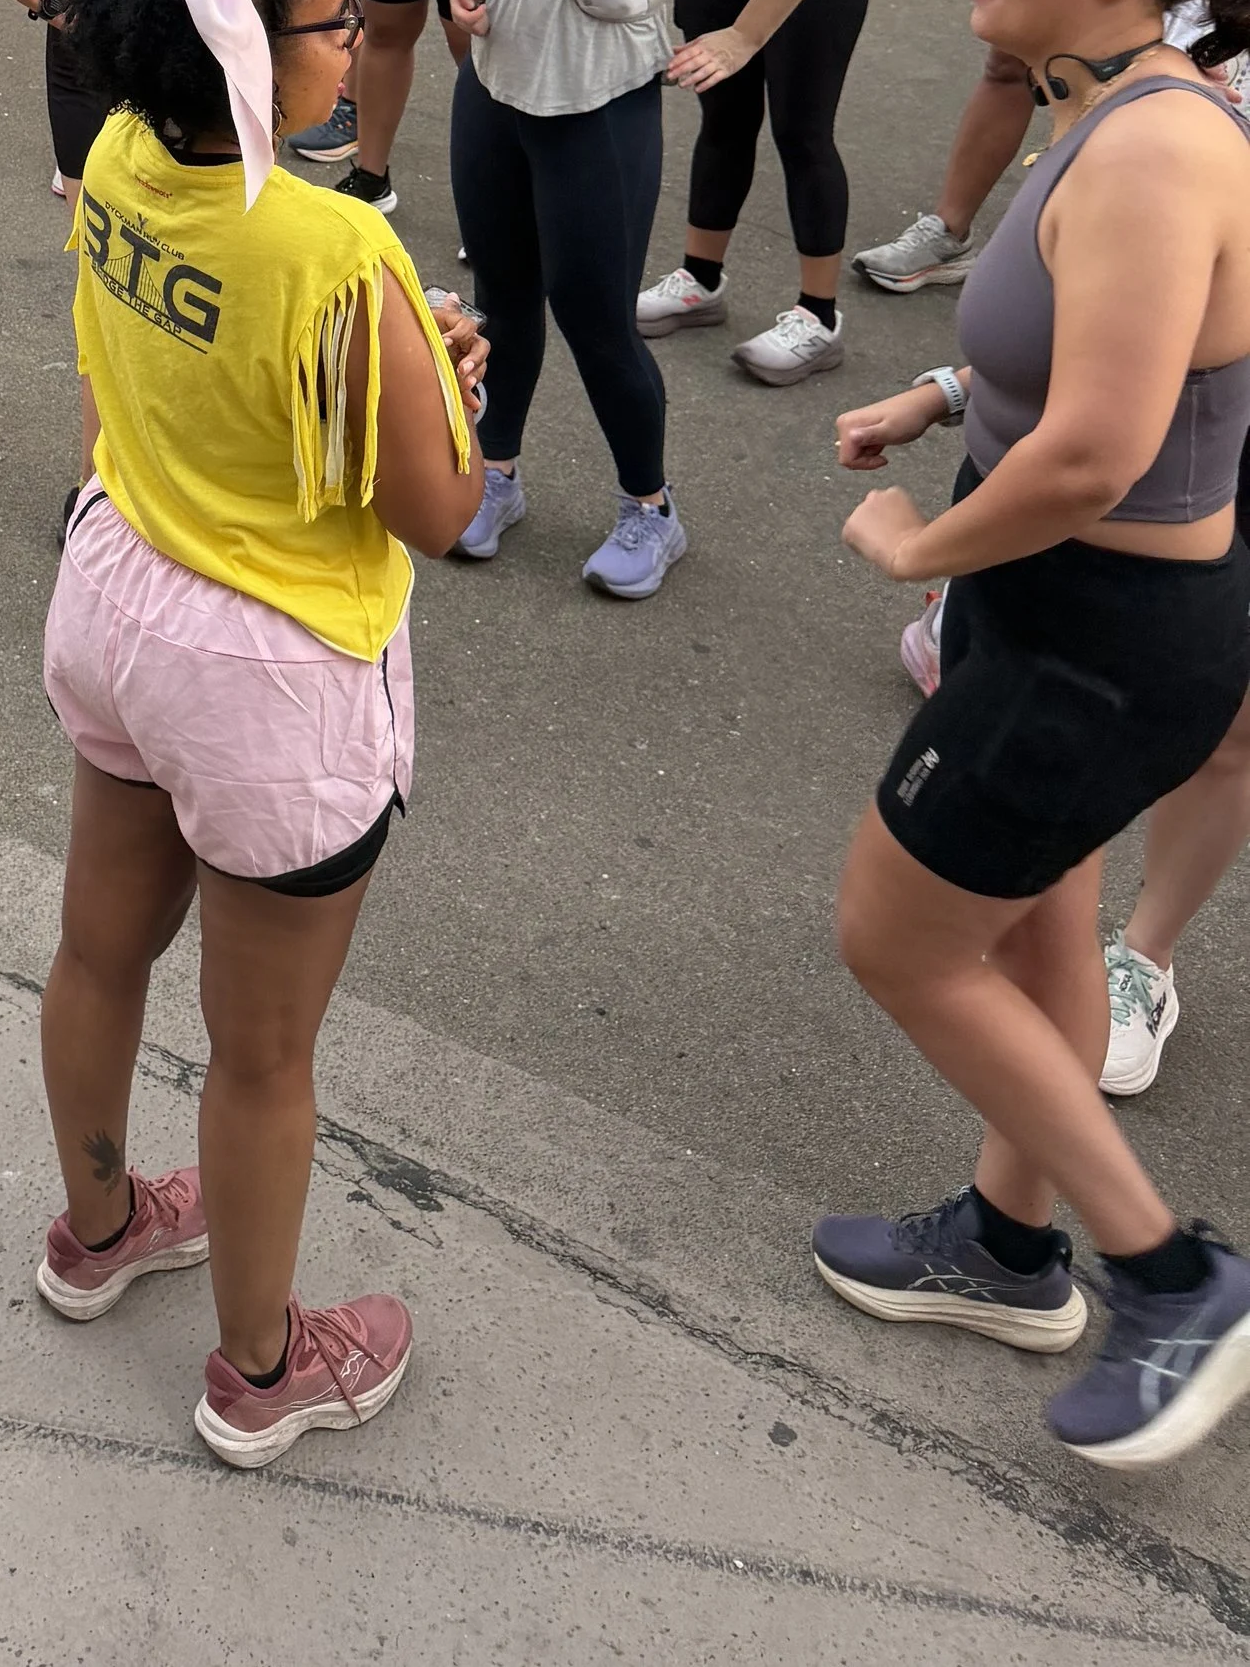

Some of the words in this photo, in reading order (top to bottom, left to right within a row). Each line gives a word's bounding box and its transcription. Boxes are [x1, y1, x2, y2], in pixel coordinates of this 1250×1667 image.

[104, 201, 142, 234] DYCKMAN
[161, 243, 185, 261] CLUB
[82, 186, 223, 344] BTG
[129, 295, 151, 317] THE
[153, 312, 183, 335] GAP
